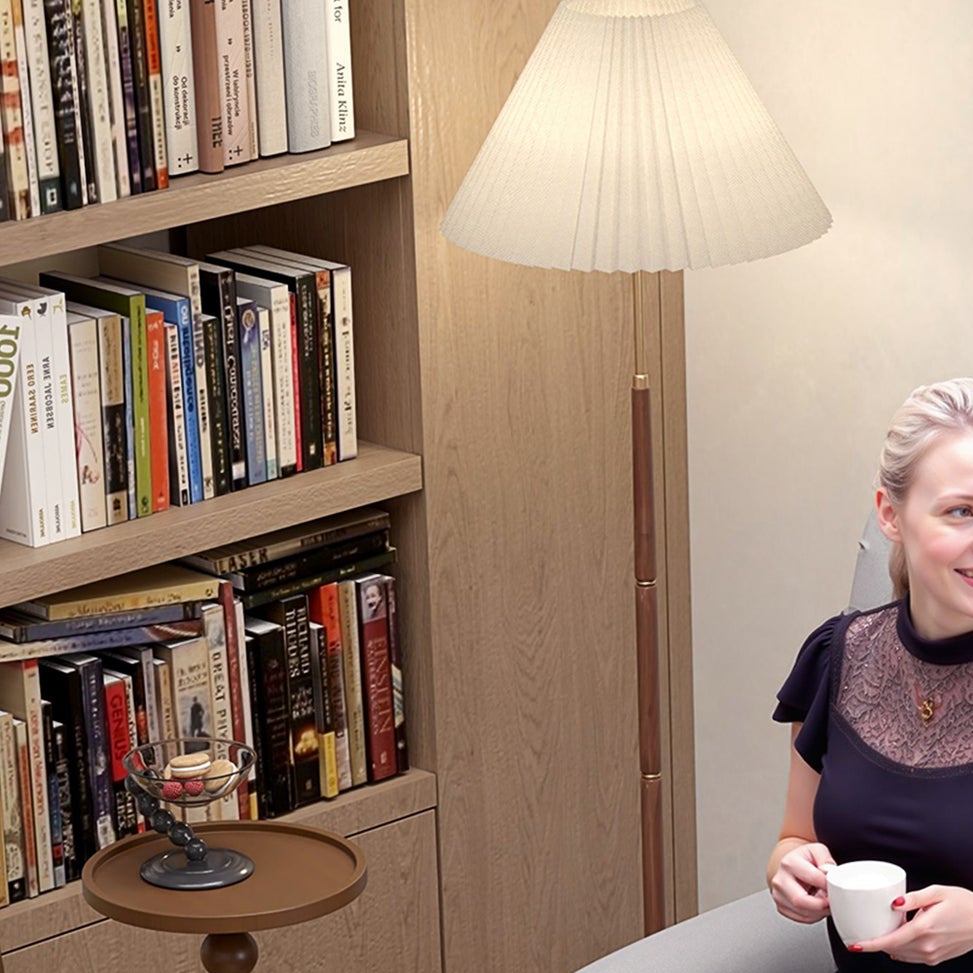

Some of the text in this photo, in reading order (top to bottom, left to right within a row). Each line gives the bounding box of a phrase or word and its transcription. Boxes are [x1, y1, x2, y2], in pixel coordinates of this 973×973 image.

[334, 6, 342, 22] for
[172, 75, 182, 130] do konstrukcji
[181, 76, 190, 125] Od dekoracji
[226, 102, 234, 135] obrazów
[336, 62, 348, 133] Anita Klinz
[216, 548, 269, 574] LASER
[297, 607, 311, 675] RICHARD
[374, 637, 392, 734] EINSTEIN
[109, 694, 124, 761] GENIUS
